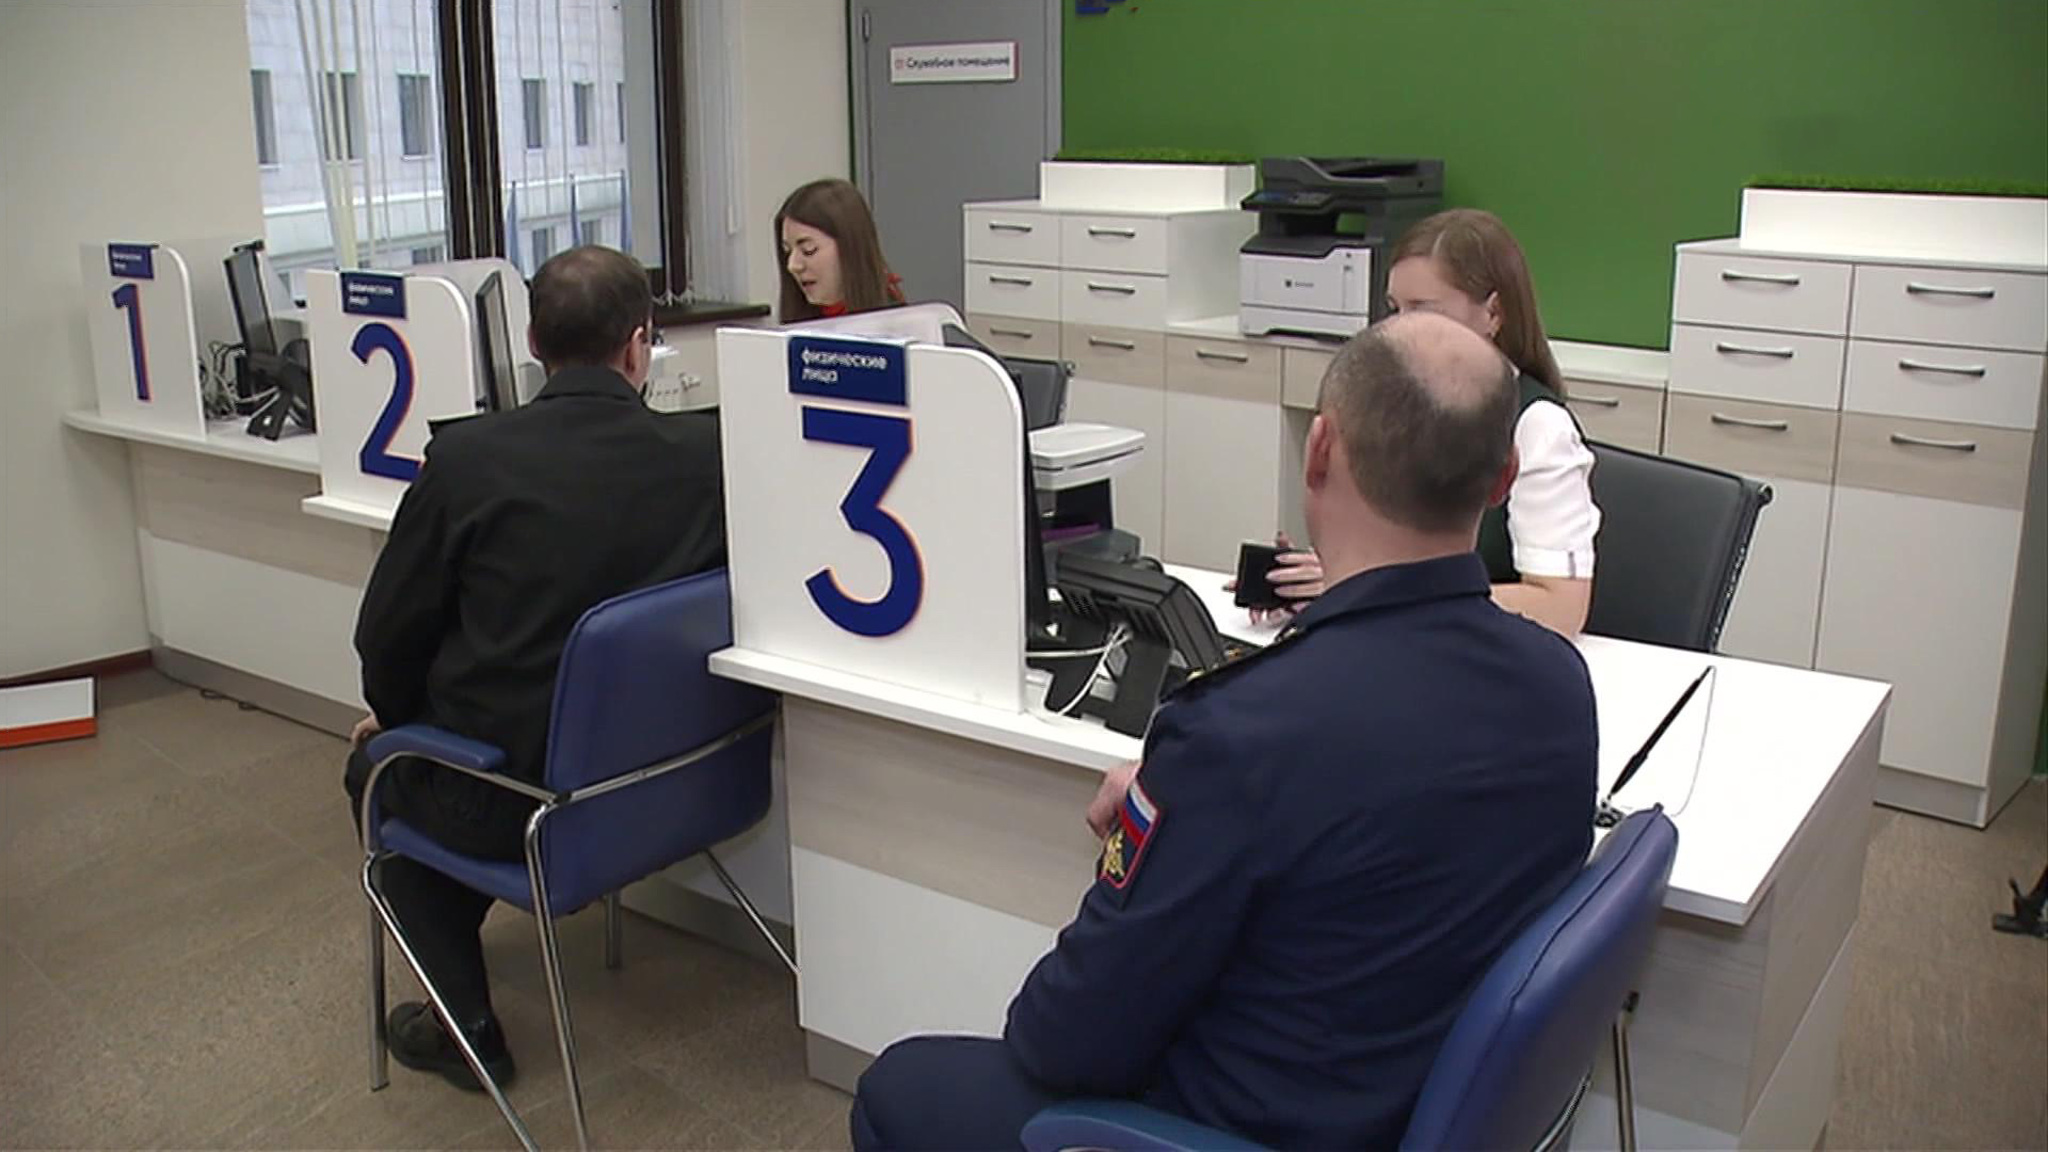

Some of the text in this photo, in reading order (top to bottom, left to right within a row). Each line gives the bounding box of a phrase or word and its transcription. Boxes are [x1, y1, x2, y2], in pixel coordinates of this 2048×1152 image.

[112, 284, 153, 401] 1
[800, 347, 888, 370] физические
[801, 368, 838, 383] лица
[351, 322, 423, 481] 2
[802, 405, 923, 637] 3
